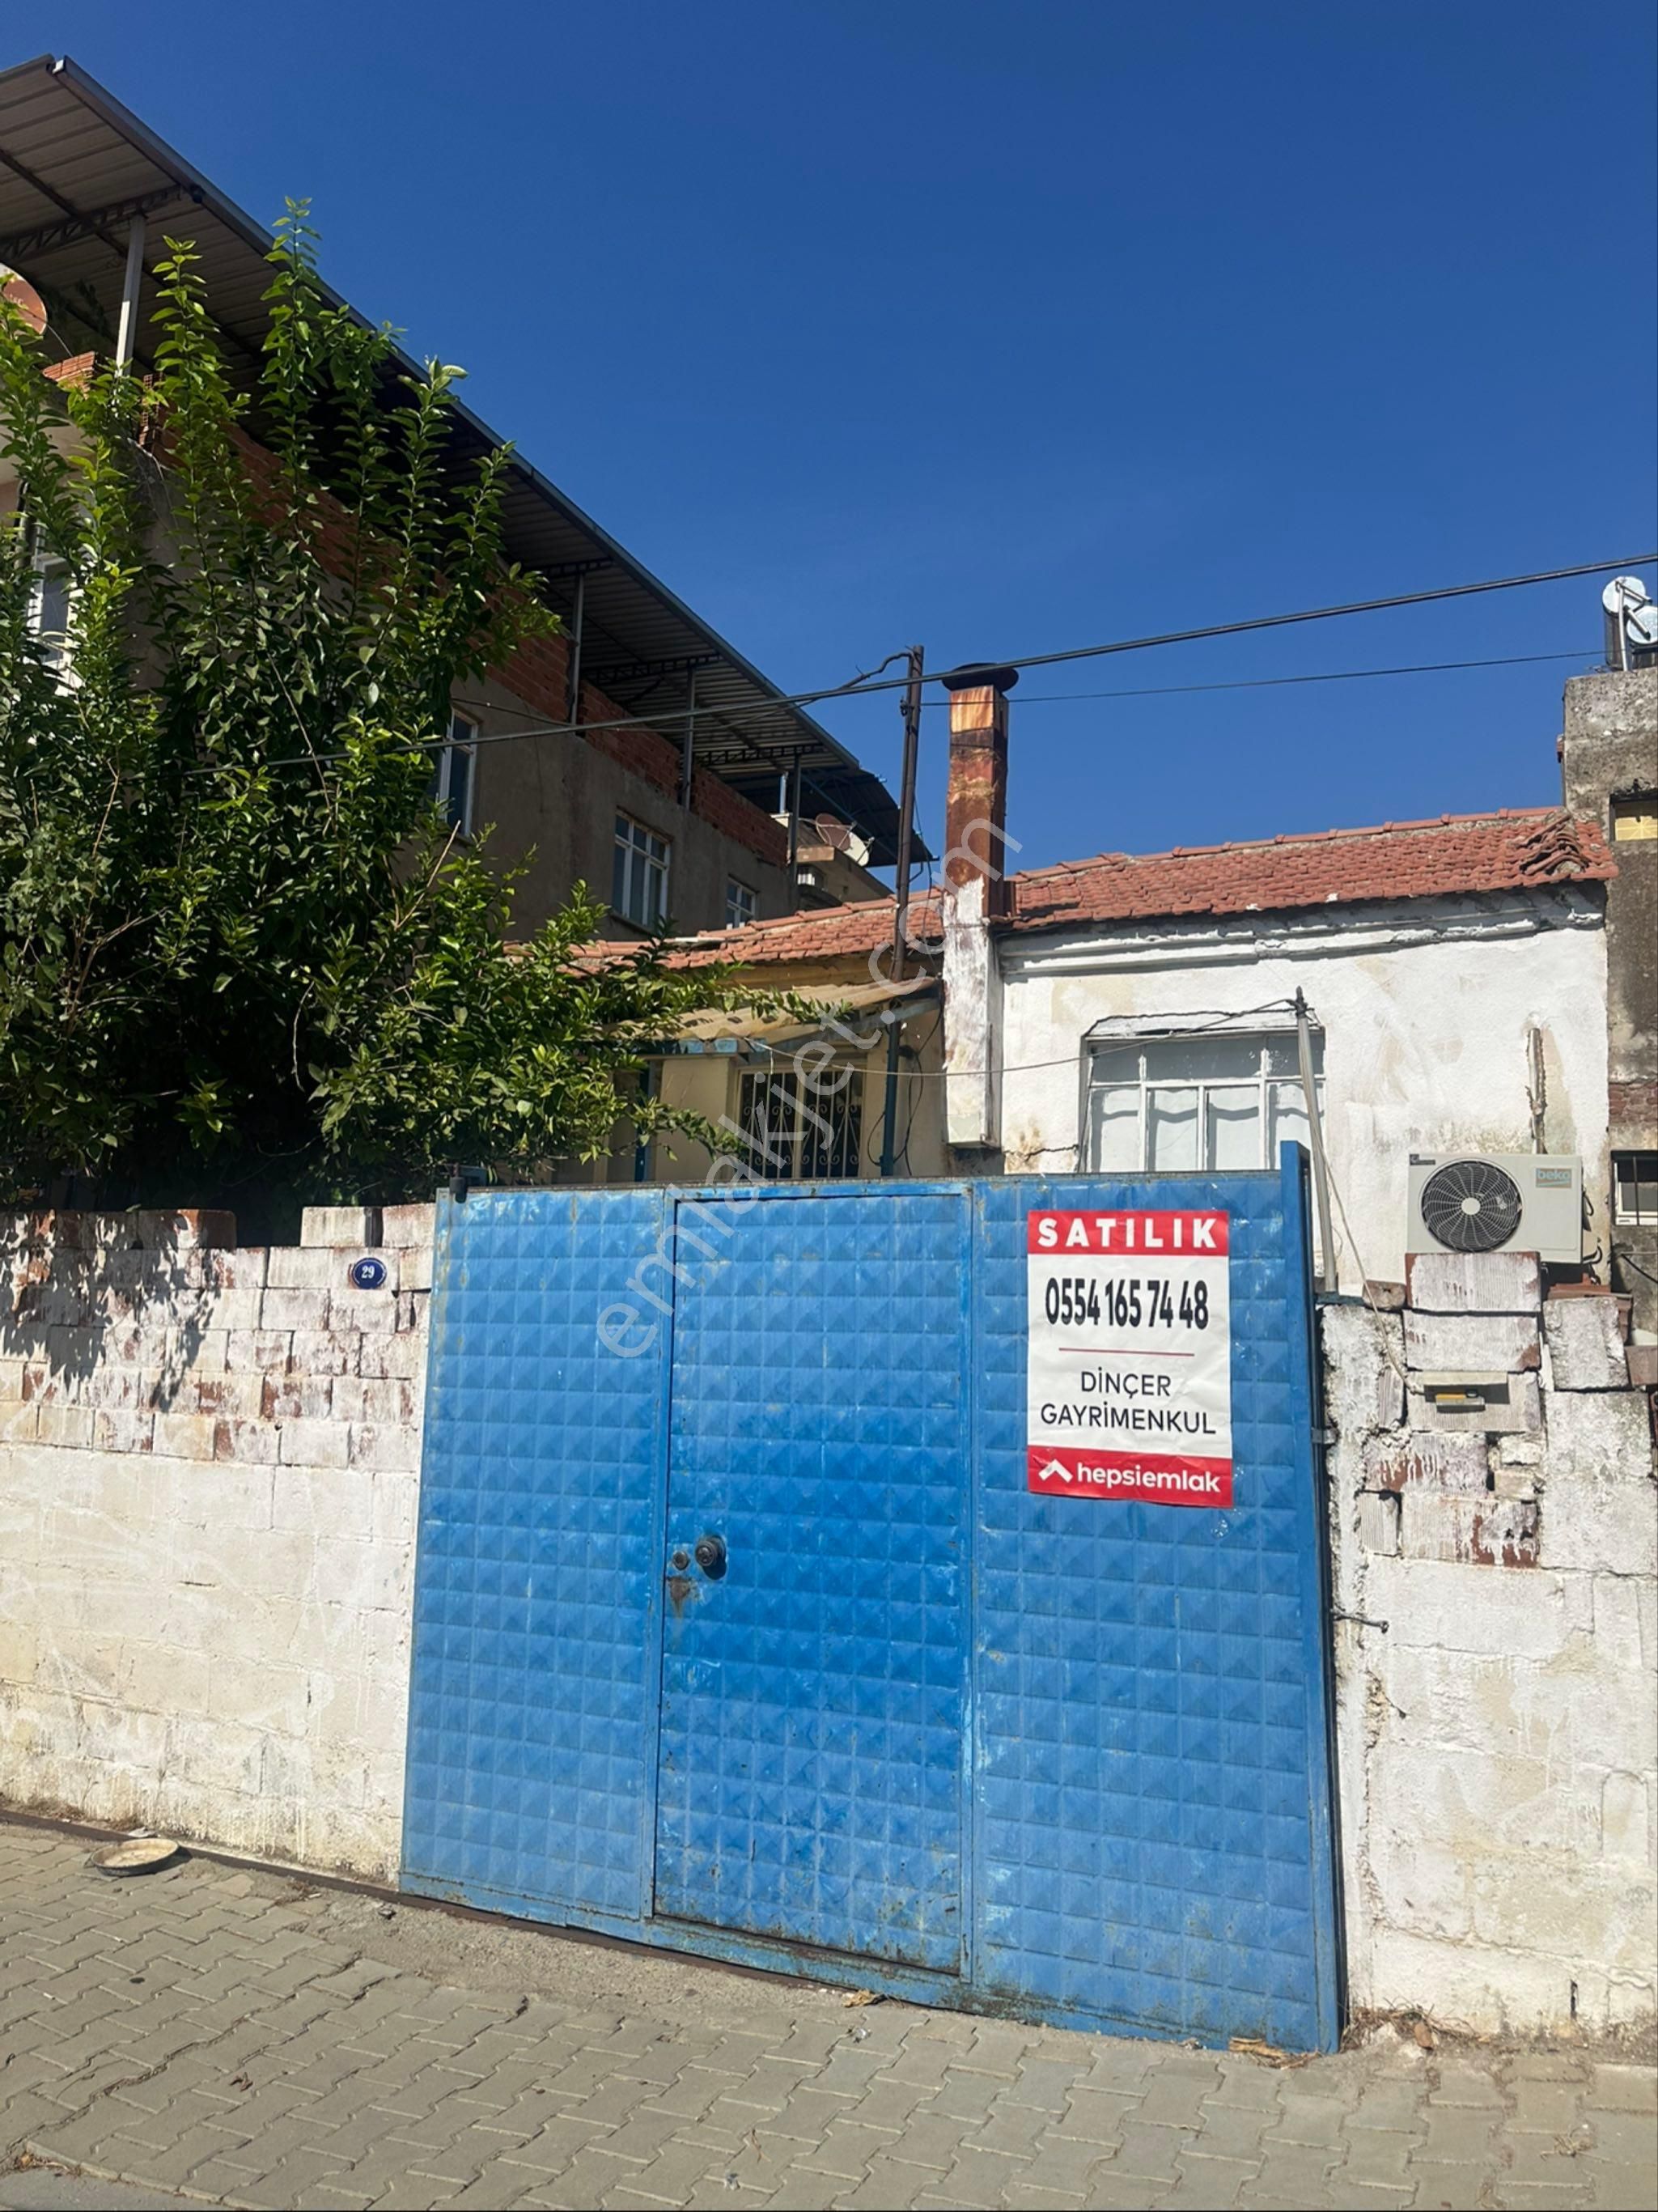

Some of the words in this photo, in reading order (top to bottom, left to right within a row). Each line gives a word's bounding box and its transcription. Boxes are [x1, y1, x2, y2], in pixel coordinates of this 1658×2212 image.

[1536, 1168, 1570, 1180] beko
[1037, 1217, 1217, 1249] SATILIK
[361, 1264, 375, 1279] 29
[1045, 1276, 1100, 1326] 0554
[1105, 1278, 1142, 1327] 165
[1147, 1279, 1174, 1328] 74
[1179, 1279, 1209, 1330] 48
[1081, 1366, 1172, 1399] DİNÇER
[1041, 1400, 1217, 1435] GAYRİMENKUL
[1077, 1462, 1221, 1492] hepsiemlak
